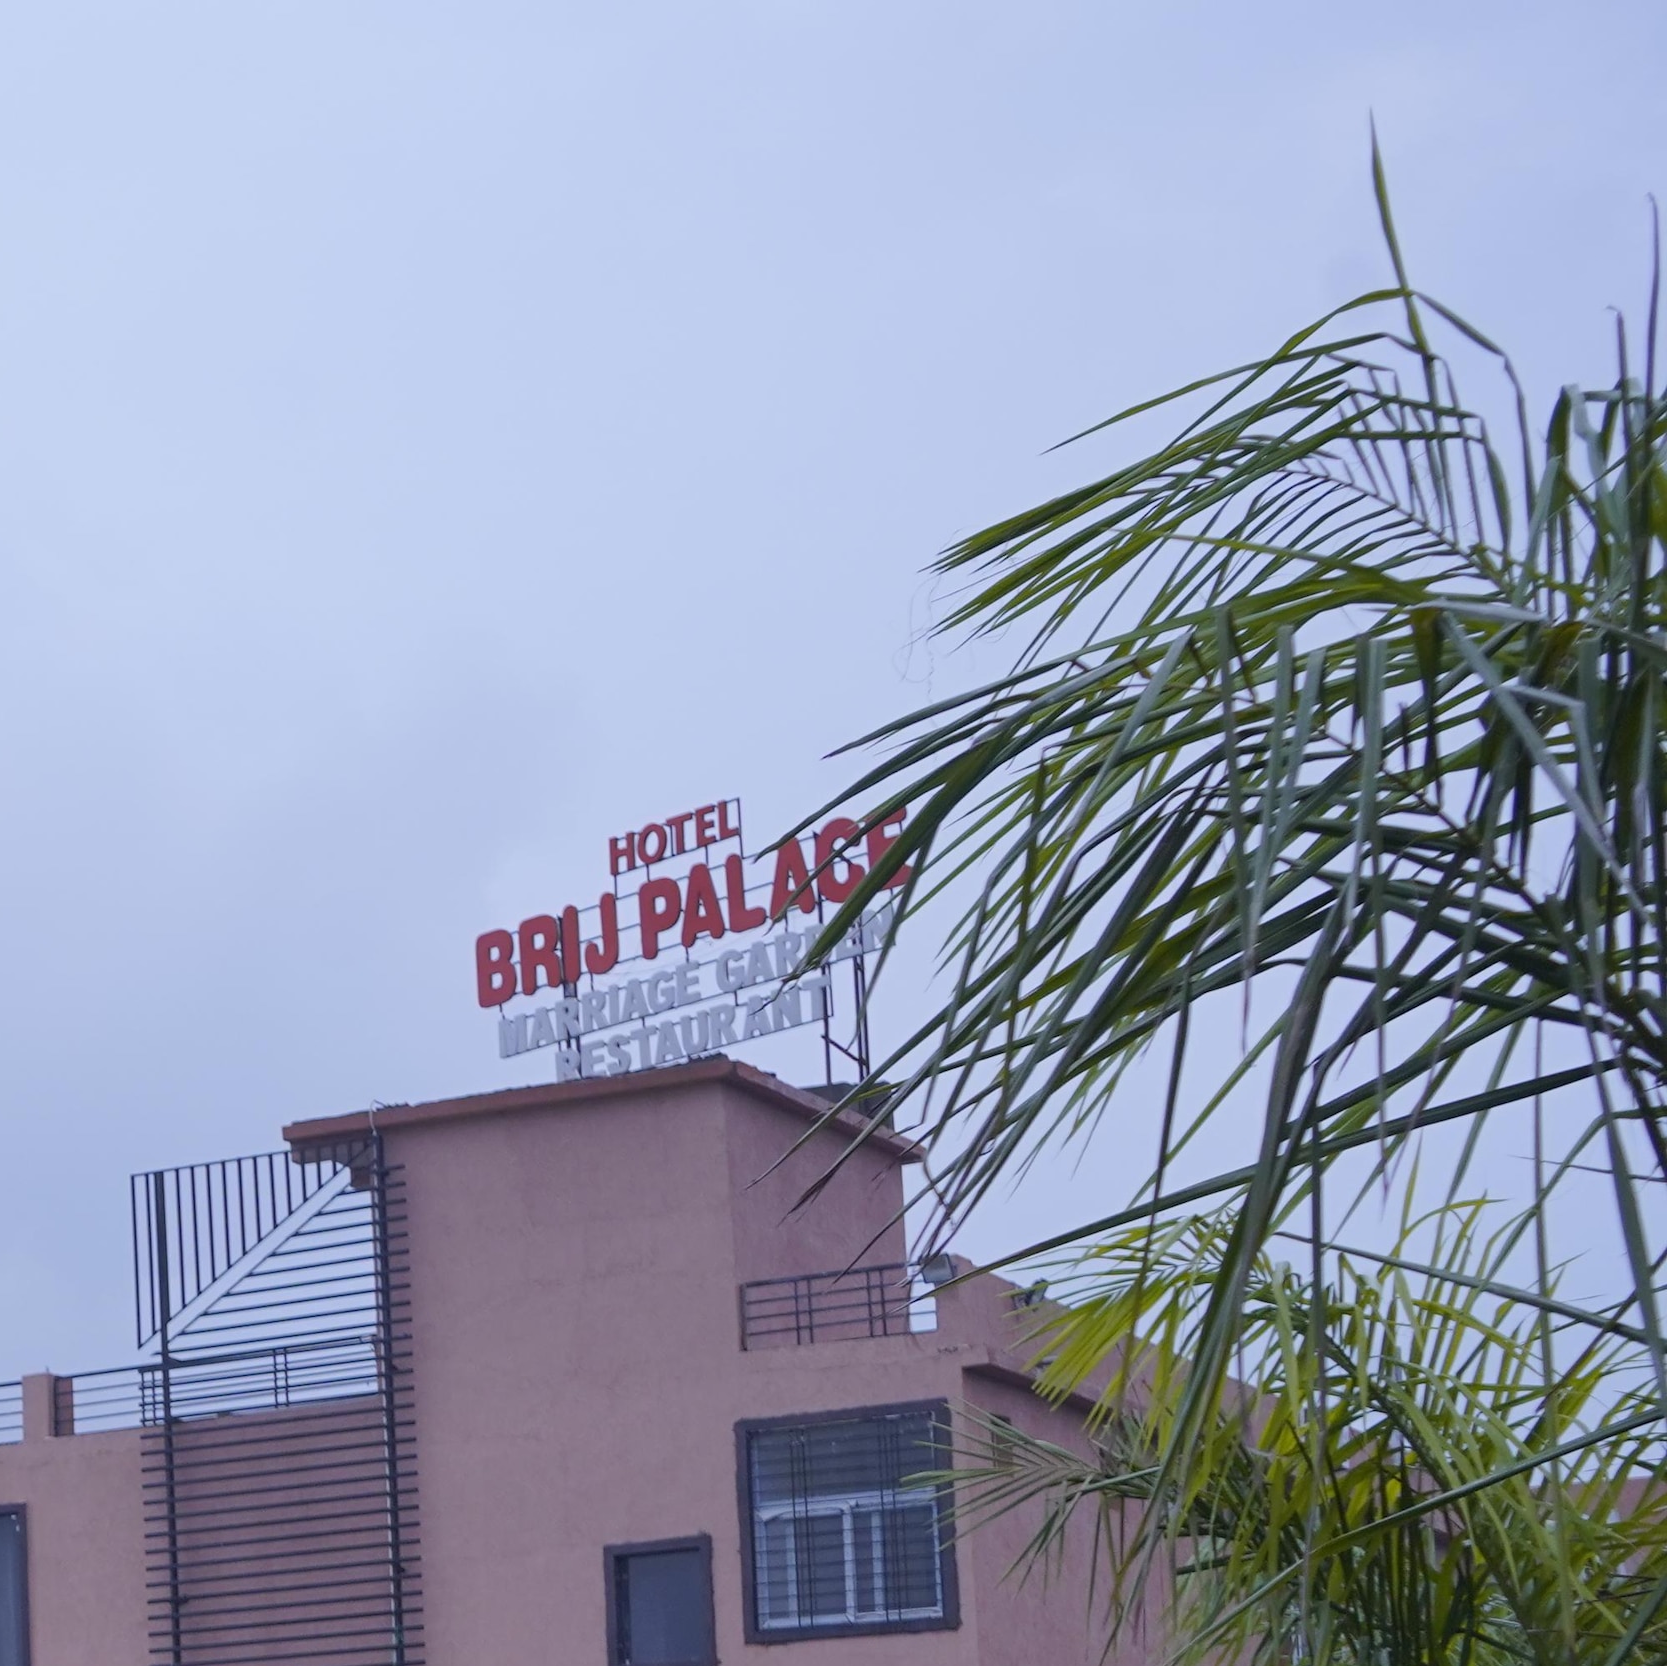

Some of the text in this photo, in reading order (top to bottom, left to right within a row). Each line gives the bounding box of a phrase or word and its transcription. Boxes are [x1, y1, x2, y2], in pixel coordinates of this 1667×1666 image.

[609, 800, 740, 875] HOTEL
[475, 892, 618, 1008] BRIJ
[498, 960, 701, 1059] MARRIAGE
[555, 973, 830, 1082] RESTAURANT
